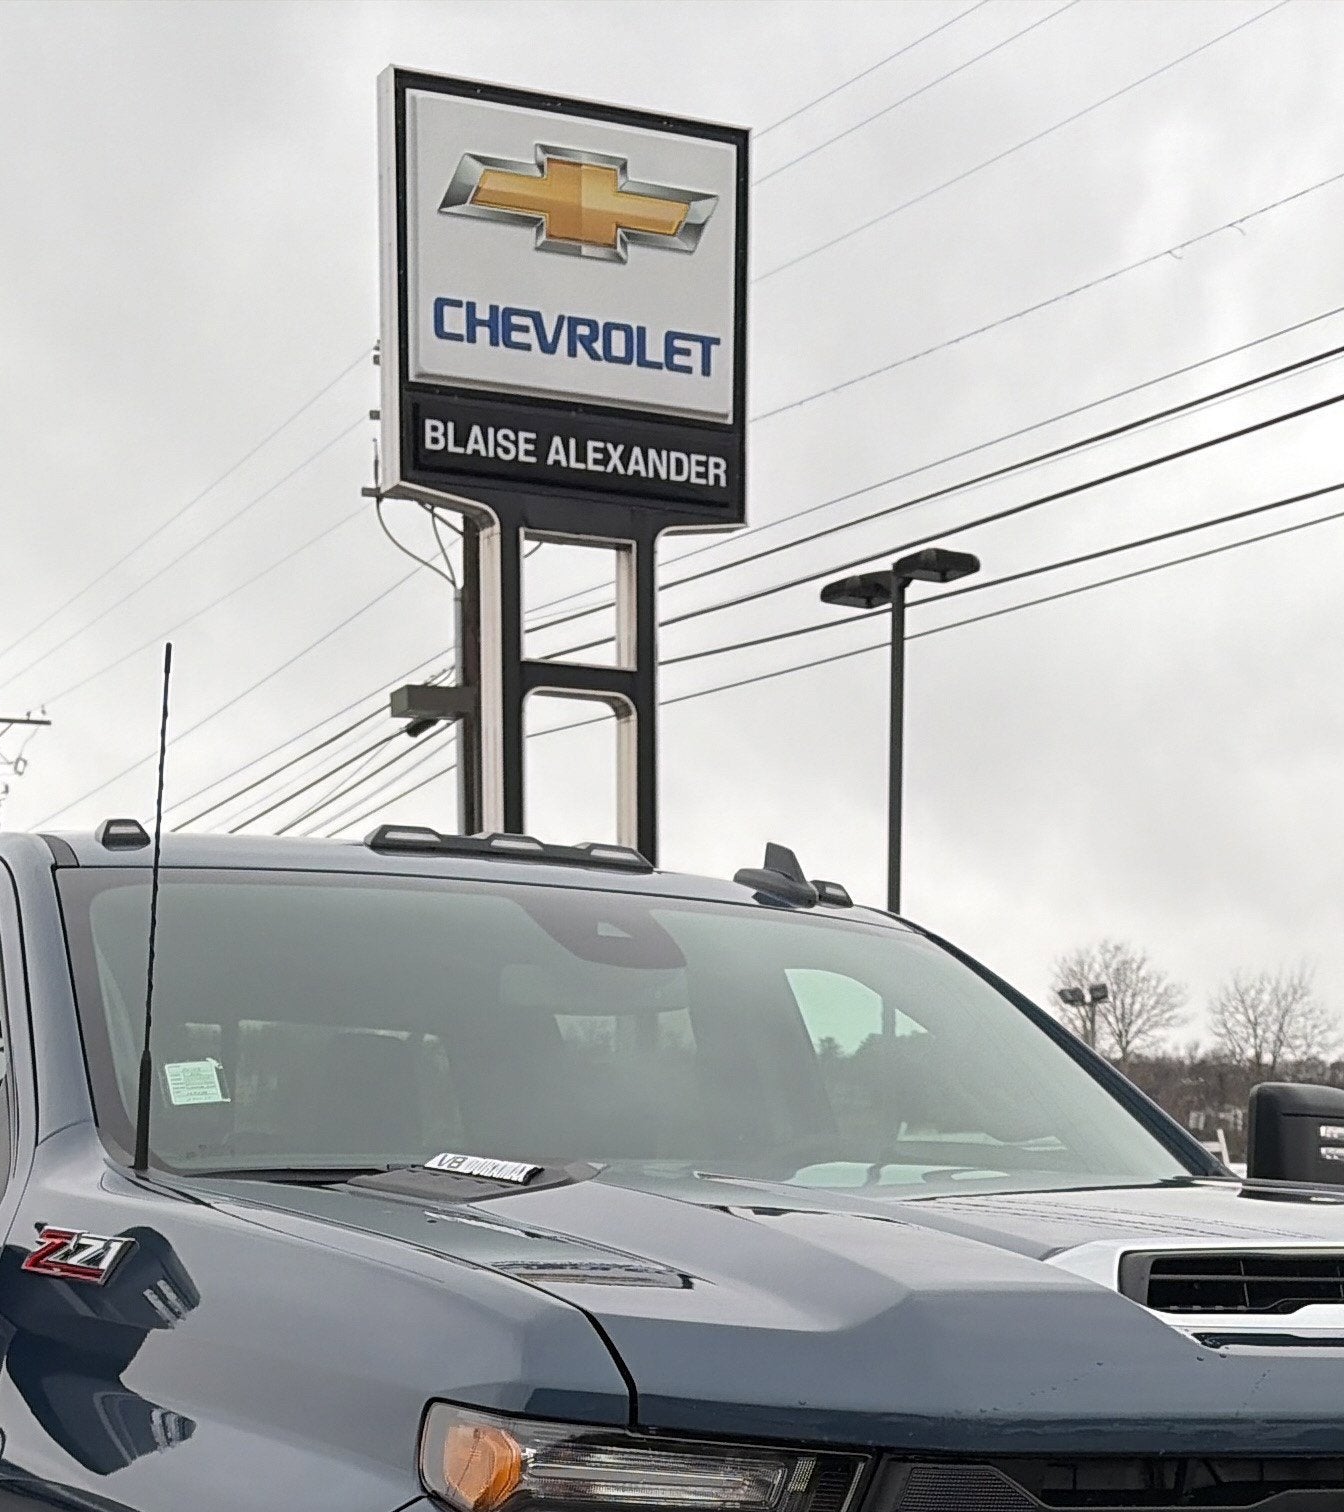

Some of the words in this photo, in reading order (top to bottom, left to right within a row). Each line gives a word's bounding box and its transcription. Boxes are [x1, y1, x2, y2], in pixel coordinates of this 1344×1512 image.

[434, 298, 720, 377] CHEVROLET
[425, 420, 537, 463] BLAISE
[548, 436, 727, 487] ALEXANDER
[22, 1226, 137, 1286] Z71
